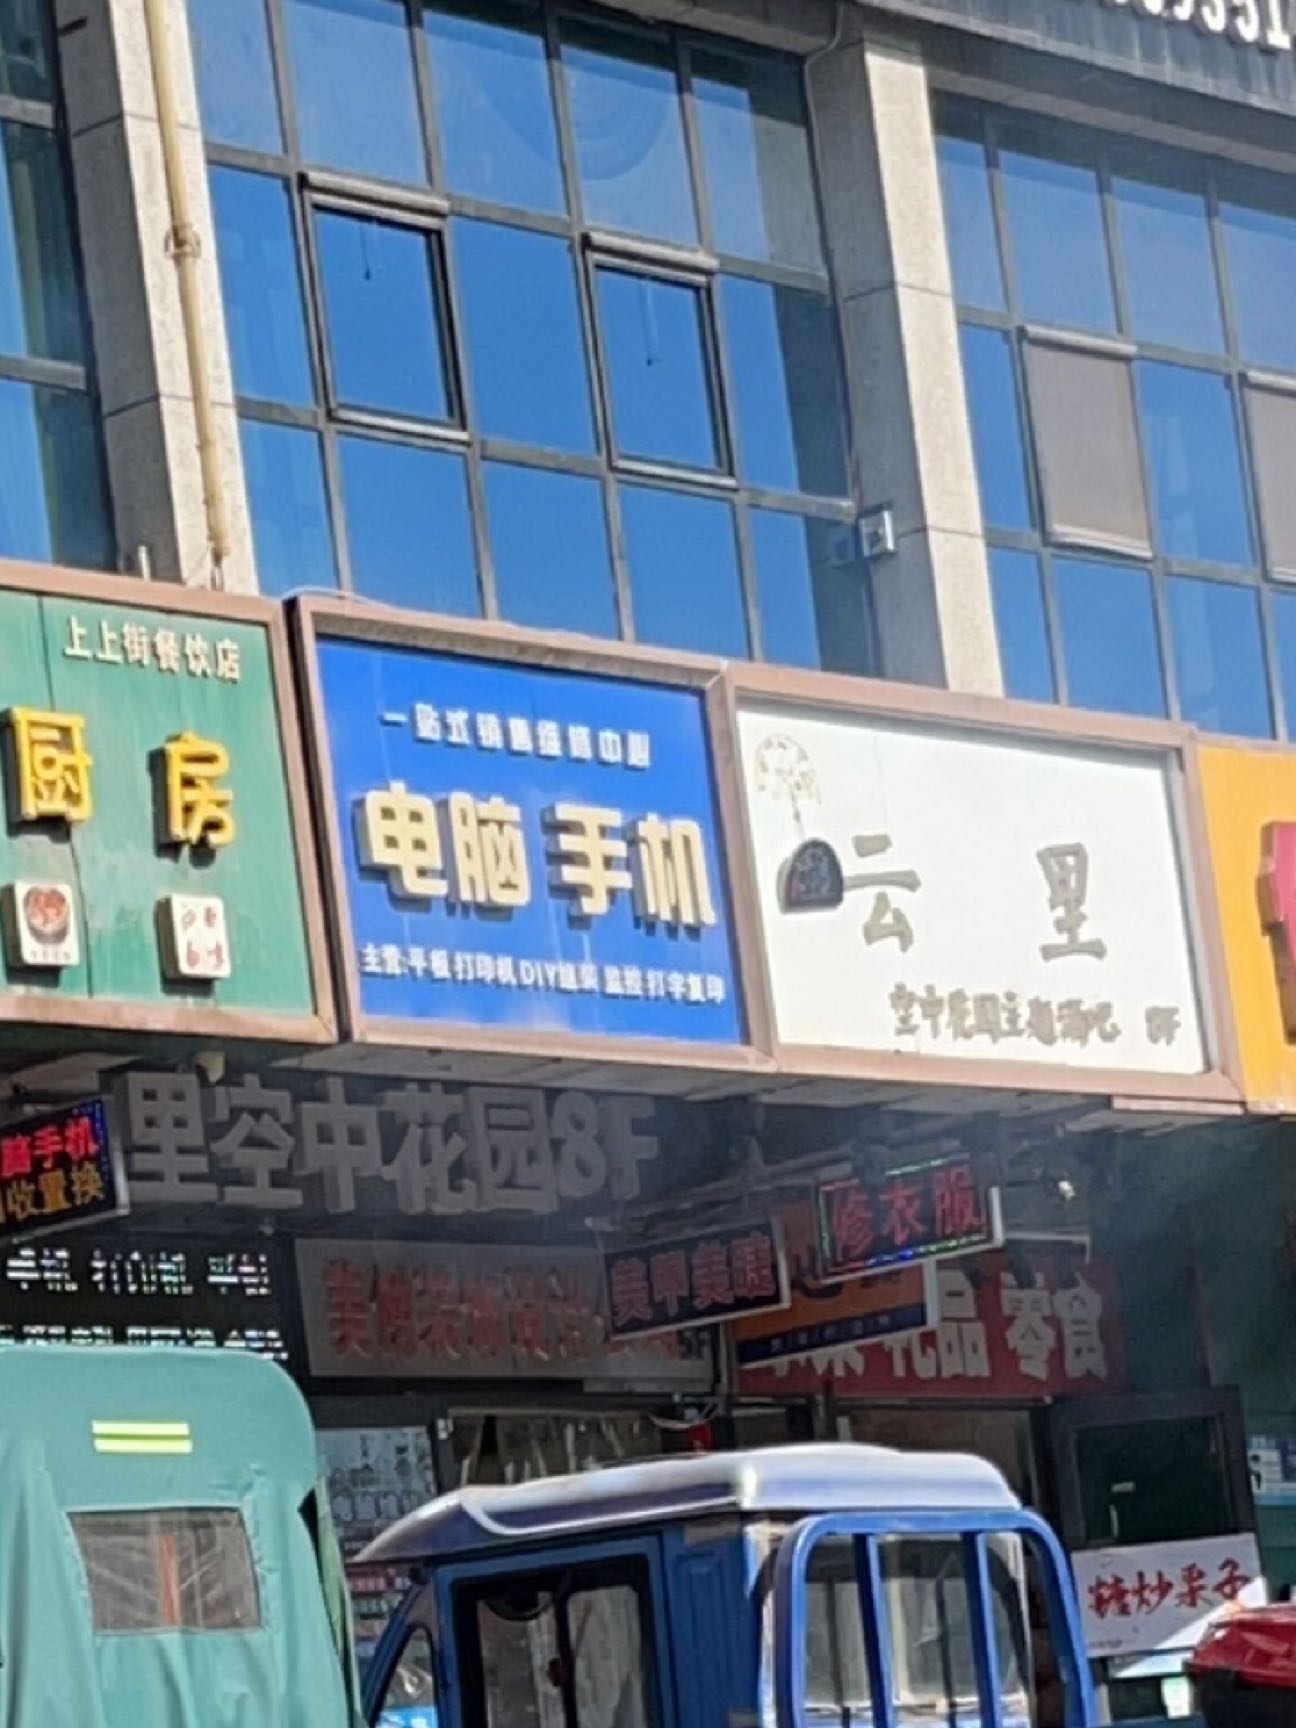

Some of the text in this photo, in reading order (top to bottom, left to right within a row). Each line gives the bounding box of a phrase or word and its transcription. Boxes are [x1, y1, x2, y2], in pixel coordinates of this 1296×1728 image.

[64, 615, 240, 683] 上上街餐饮店
[11, 706, 235, 848] 厨房
[360, 780, 718, 926] 电脑 手机
[842, 833, 1108, 963] 云里
[126, 1070, 660, 1216] 里空中花园8F
[831, 1165, 987, 1264] 修衣服
[1000, 1270, 1107, 1382] 零食
[1088, 1556, 1252, 1619] 糖炒栗子
